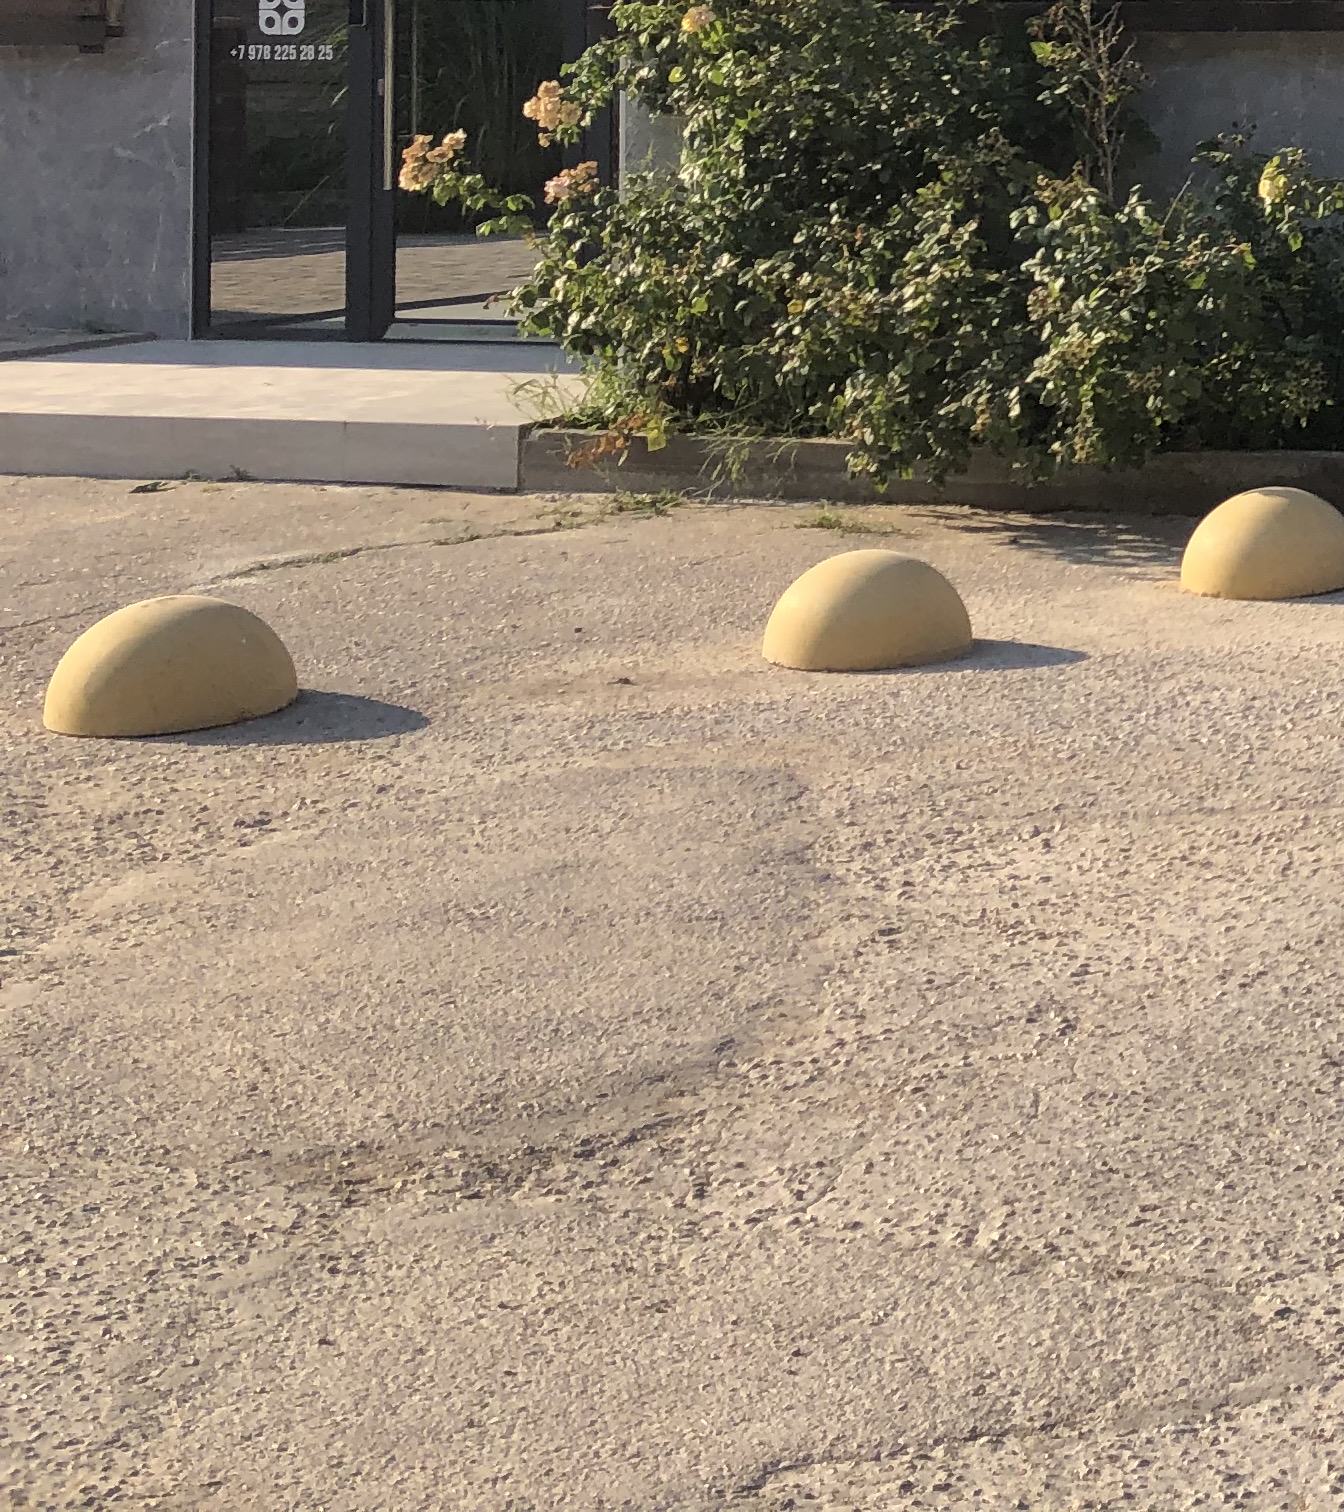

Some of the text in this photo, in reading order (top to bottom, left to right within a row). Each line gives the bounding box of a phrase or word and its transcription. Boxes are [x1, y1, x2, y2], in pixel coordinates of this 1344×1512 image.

[230, 45, 245, 60] +7
[248, 45, 271, 60] 978
[274, 45, 297, 60] 225
[318, 45, 334, 60] 25
